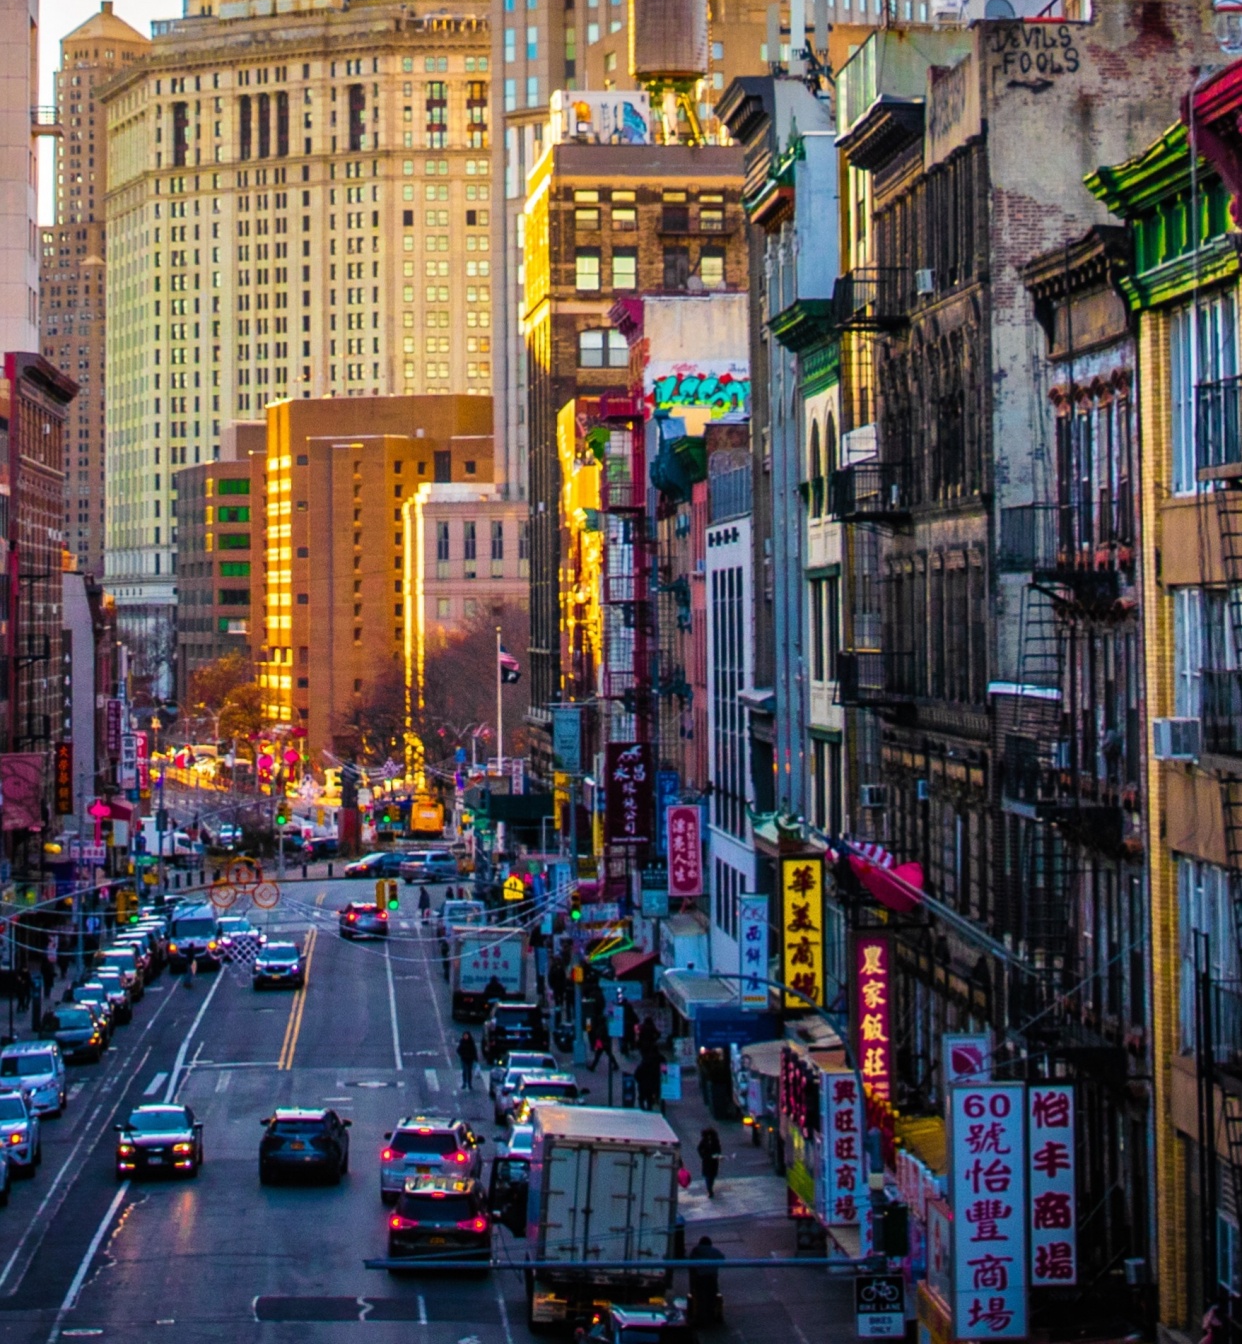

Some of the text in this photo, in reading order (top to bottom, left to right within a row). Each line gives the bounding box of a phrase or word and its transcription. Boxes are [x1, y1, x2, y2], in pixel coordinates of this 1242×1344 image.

[1003, 47, 1080, 75] FOOLS
[859, 1302, 901, 1311] BIKE LANE
[868, 1316, 893, 1325] BIKES
[870, 1325, 891, 1335] ONLY
